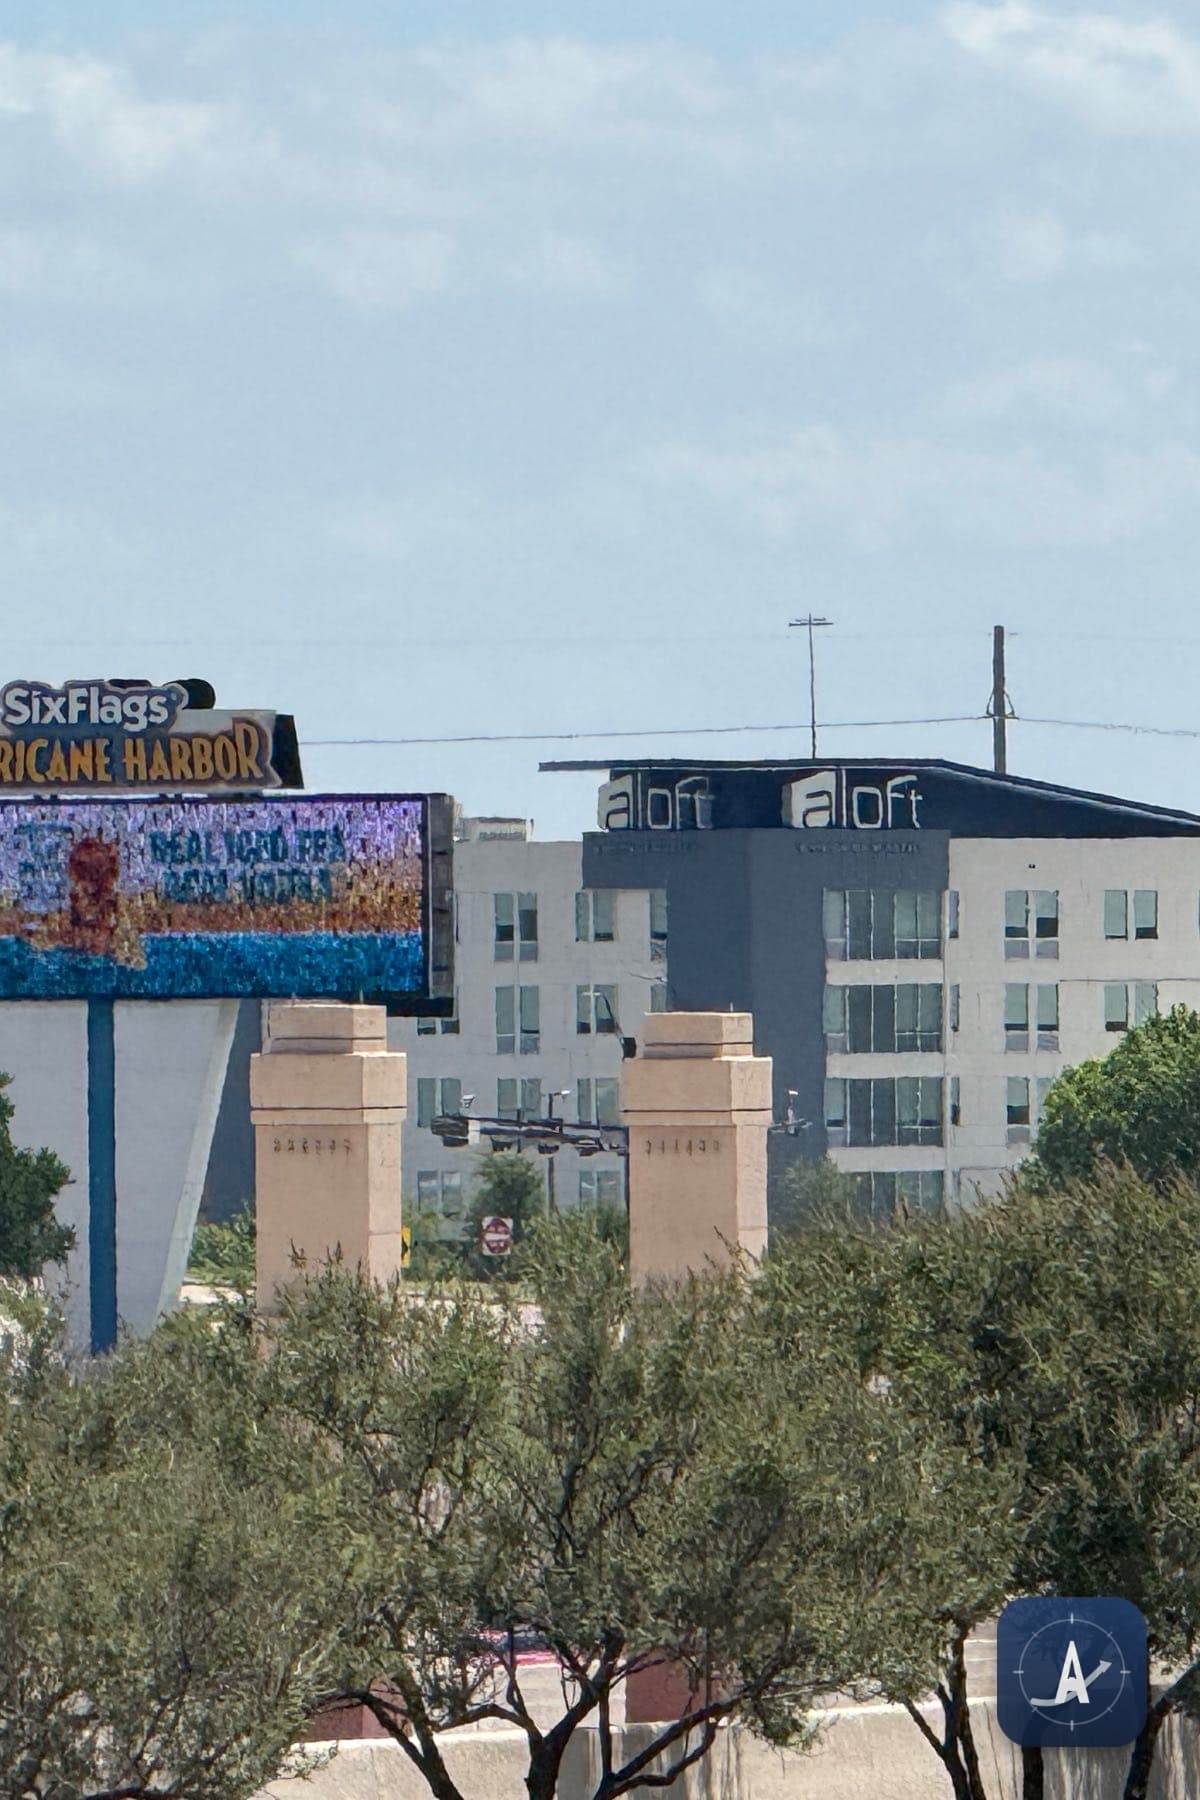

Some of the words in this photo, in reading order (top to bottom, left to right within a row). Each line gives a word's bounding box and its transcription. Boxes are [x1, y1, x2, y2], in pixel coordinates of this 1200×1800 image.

[4, 687, 169, 732] SixFlags
[123, 721, 264, 781] HARBOR
[781, 770, 923, 830] aloft
